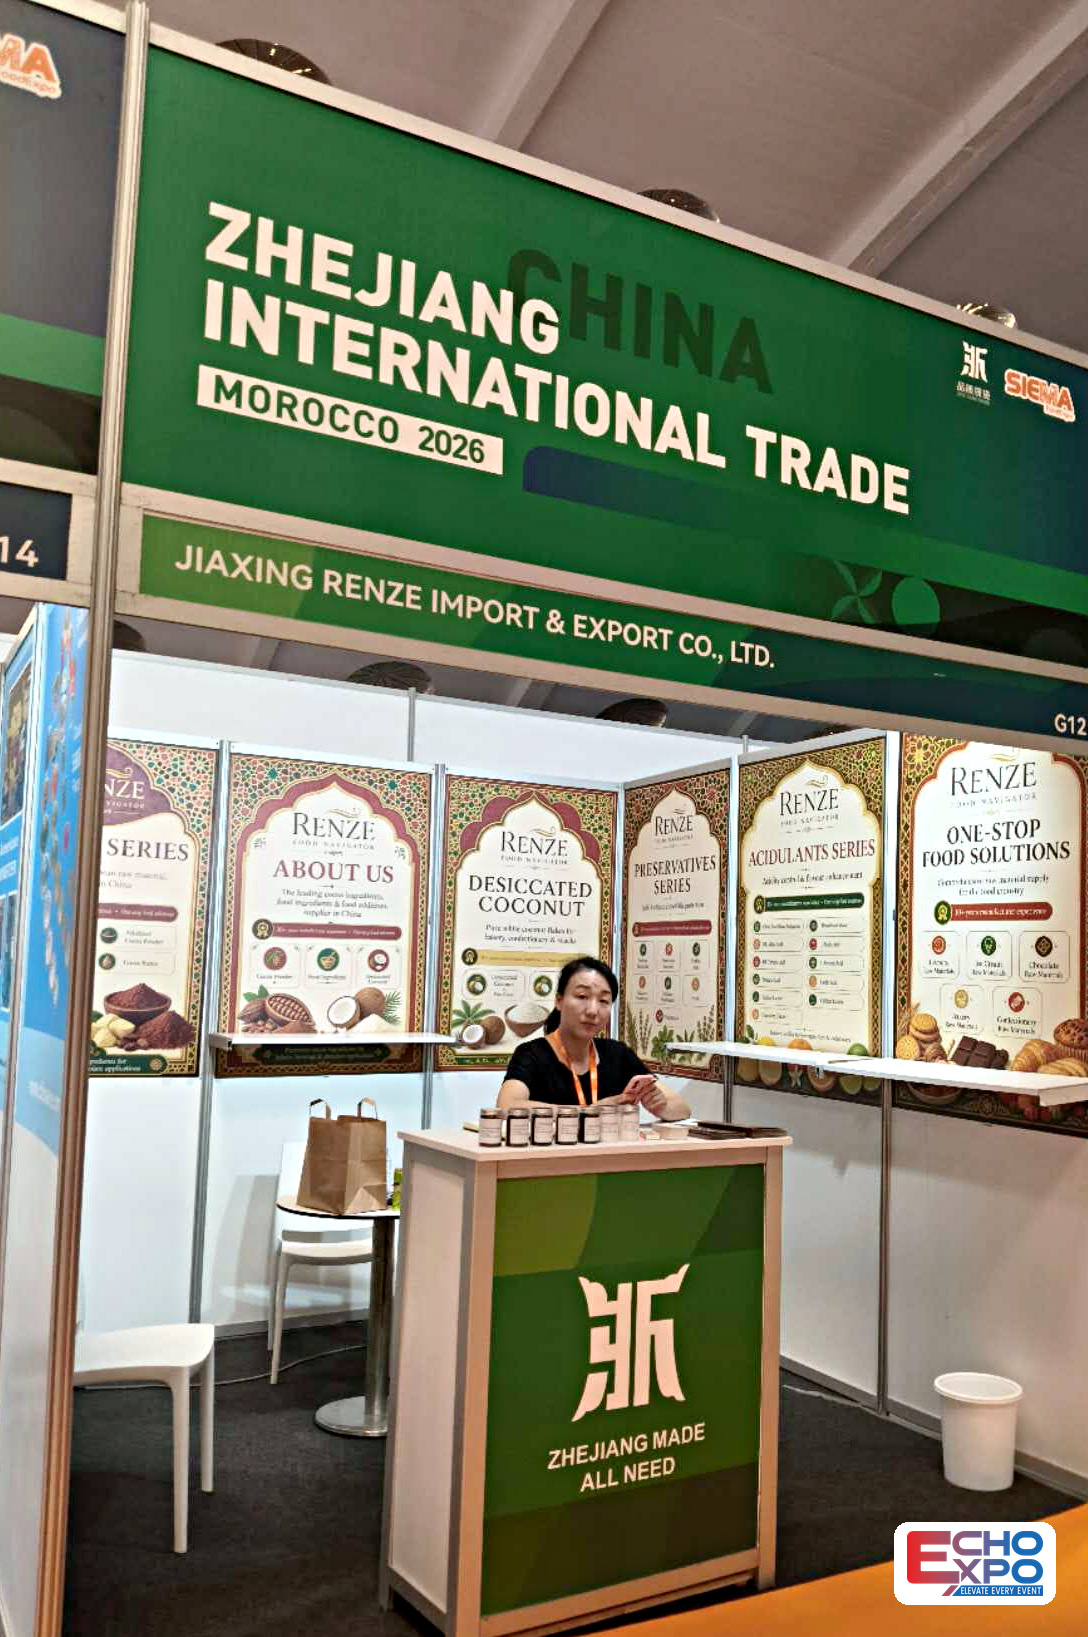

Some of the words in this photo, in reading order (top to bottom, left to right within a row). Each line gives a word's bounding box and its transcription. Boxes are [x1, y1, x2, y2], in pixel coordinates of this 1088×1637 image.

[205, 202, 559, 355] ZHEJIANG
[509, 249, 773, 395] CHINA
[205, 279, 726, 469] INTERNATIONAL
[746, 425, 910, 515] TRADE
[1005, 369, 1073, 412] SIEMA
[213, 375, 399, 443] MOROCCO
[418, 426, 485, 463] 2026
[175, 544, 314, 591] JIAXING
[323, 570, 422, 611] RENZE
[431, 589, 540, 631] IMPORT
[546, 610, 565, 634] &
[573, 614, 673, 652] EXPORT
[679, 633, 724, 663] CO.,
[730, 641, 776, 668] LTD.
[1054, 713, 1087, 736] G12
[952, 762, 1037, 796] RENZE
[780, 788, 839, 816] RENZE
[293, 812, 376, 840] RENZE
[655, 815, 693, 836] RENZE
[947, 819, 1041, 845] ONE-STOP
[106, 838, 189, 862] SERIES
[501, 831, 568, 857] RENZE
[748, 843, 829, 867] ACIDULANTS
[832, 838, 875, 860] SERIES
[923, 849, 965, 867] FOOD
[970, 841, 1070, 865] SOLUTIONS
[274, 860, 360, 881] ABOUT
[366, 864, 394, 883] US
[634, 855, 716, 878] PRESERVATIVES
[469, 875, 592, 898] DESICCATED
[654, 877, 691, 895] SERIES
[479, 897, 585, 917] COCONUT
[547, 1434, 648, 1470] ZHEJIANG
[652, 1422, 706, 1449] MADE
[580, 1468, 618, 1493] ALL
[624, 1457, 676, 1483] NEED
